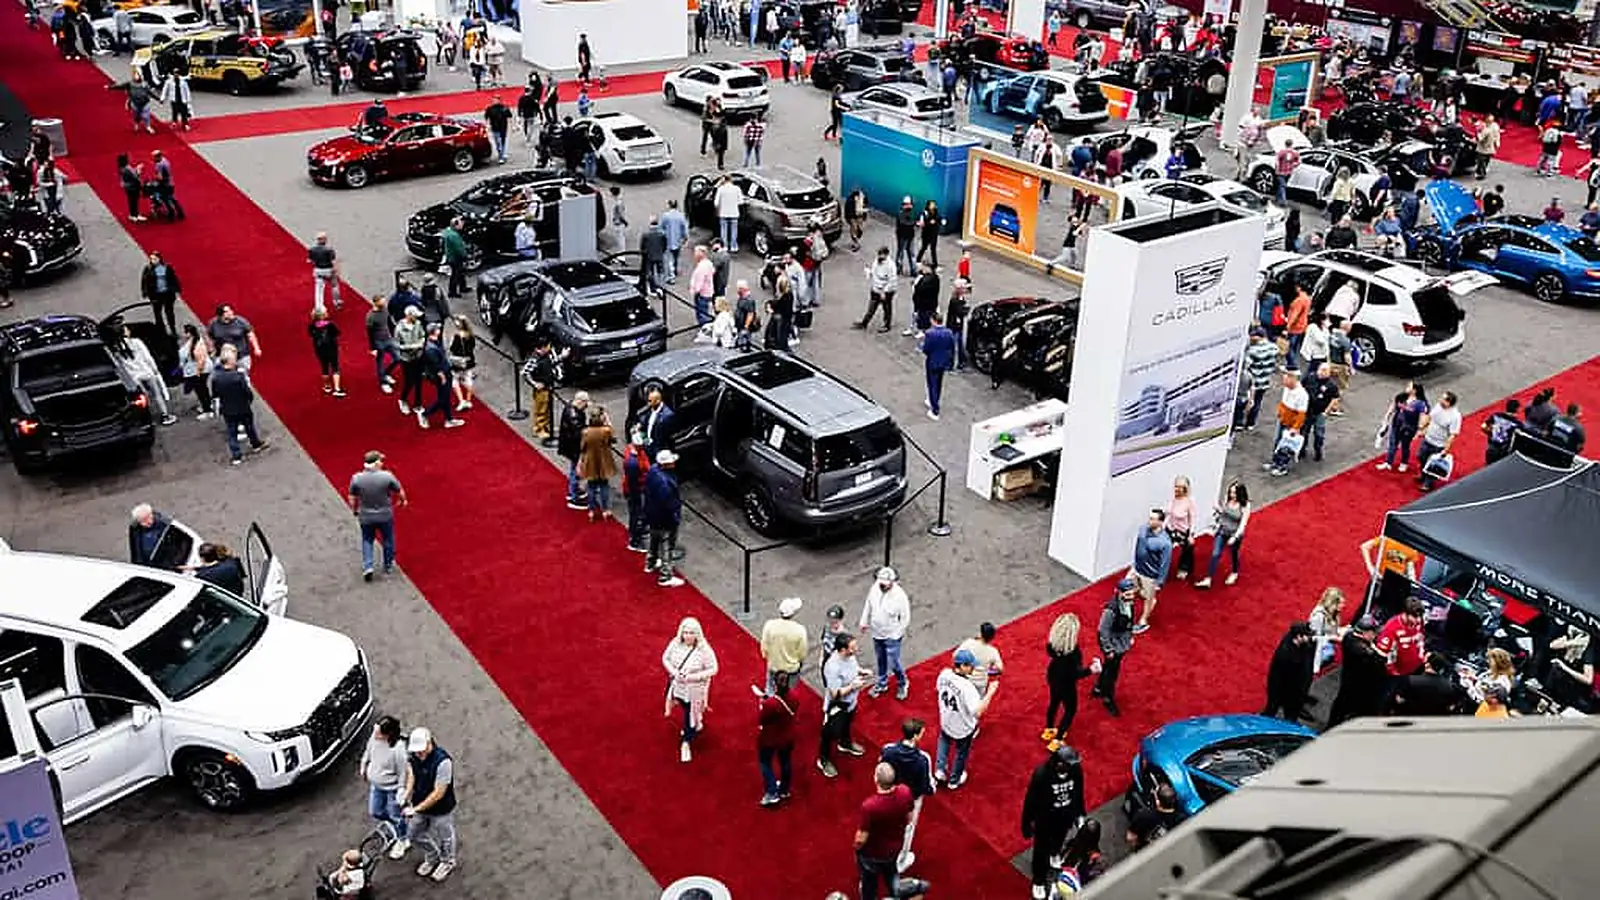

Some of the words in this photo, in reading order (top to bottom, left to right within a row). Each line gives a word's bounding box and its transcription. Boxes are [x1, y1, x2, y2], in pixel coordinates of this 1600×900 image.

[1151, 291, 1236, 326] CADILLAC
[1479, 565, 1539, 600] MORE
[1544, 594, 1600, 630] THAN
